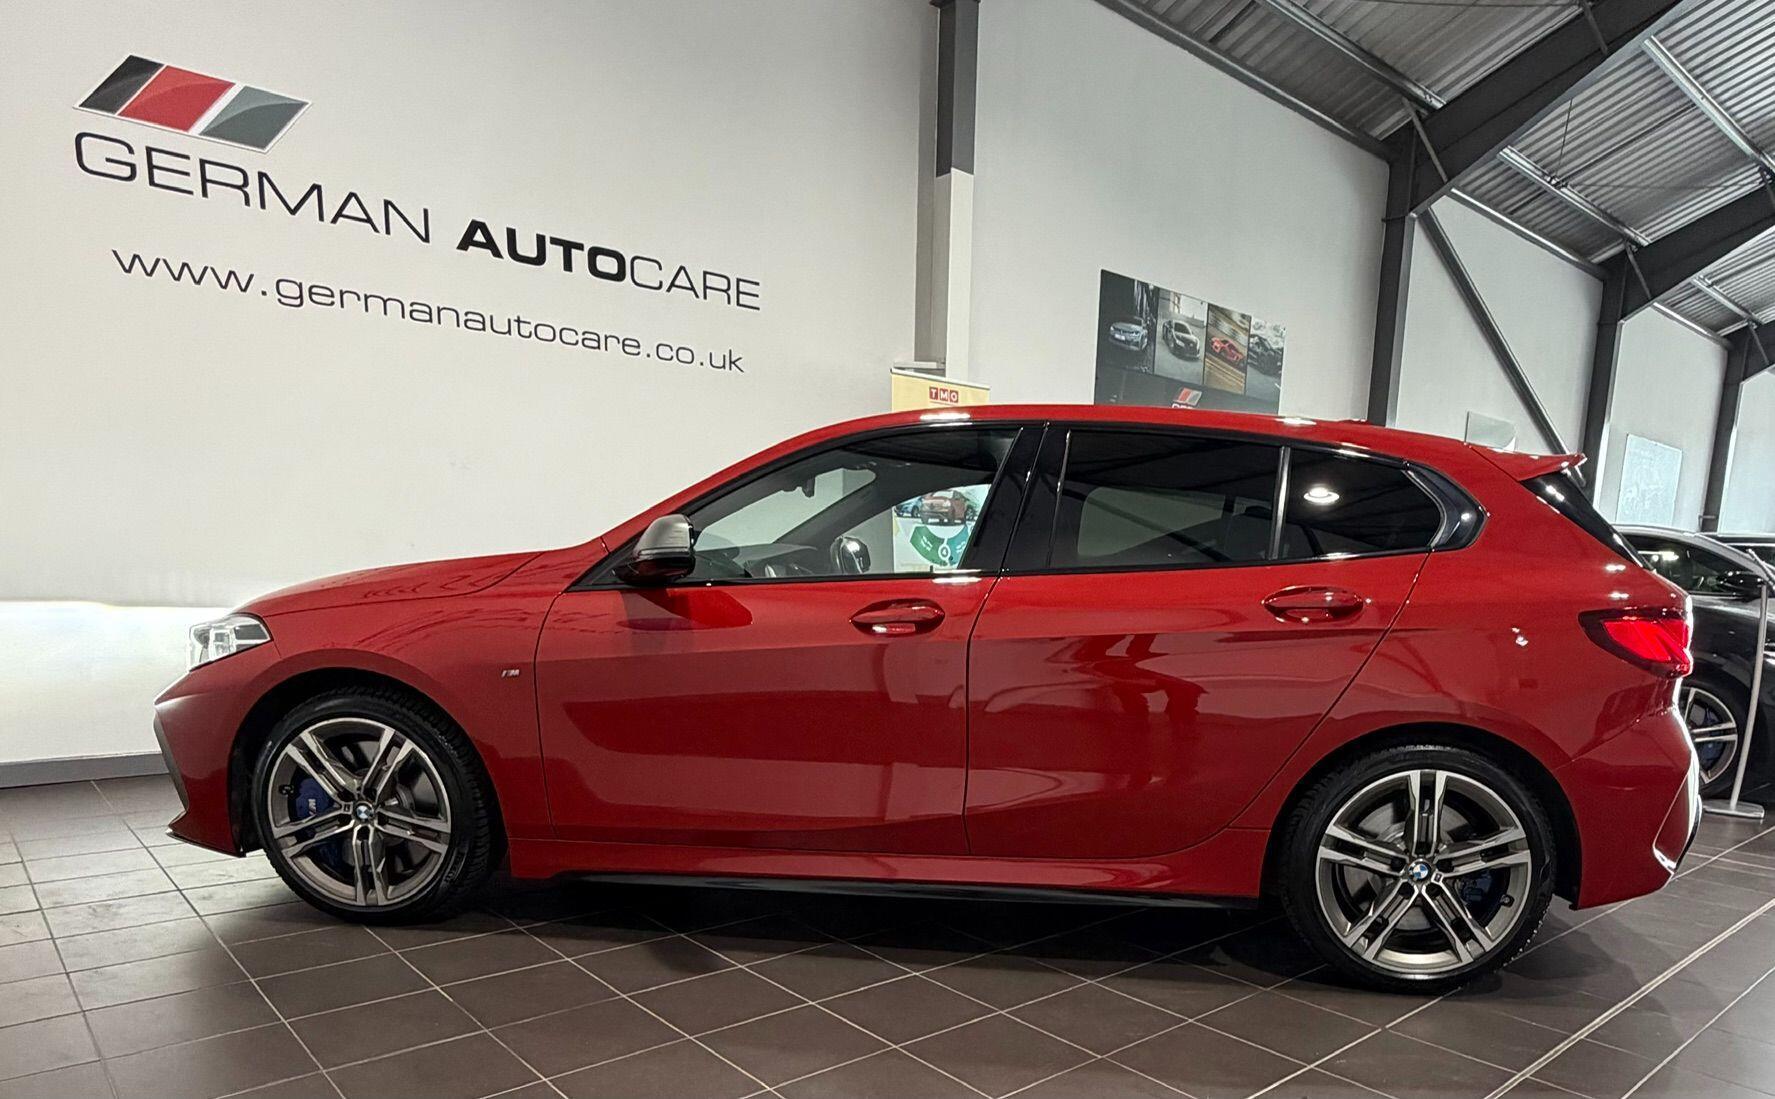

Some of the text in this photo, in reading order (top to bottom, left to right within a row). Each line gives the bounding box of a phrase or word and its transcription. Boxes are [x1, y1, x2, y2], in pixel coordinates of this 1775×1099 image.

[75, 131, 761, 312] GERMAN AUTOCARE
[112, 248, 745, 373] www.germanautocare.co.uk
[930, 388, 958, 402] TMO
